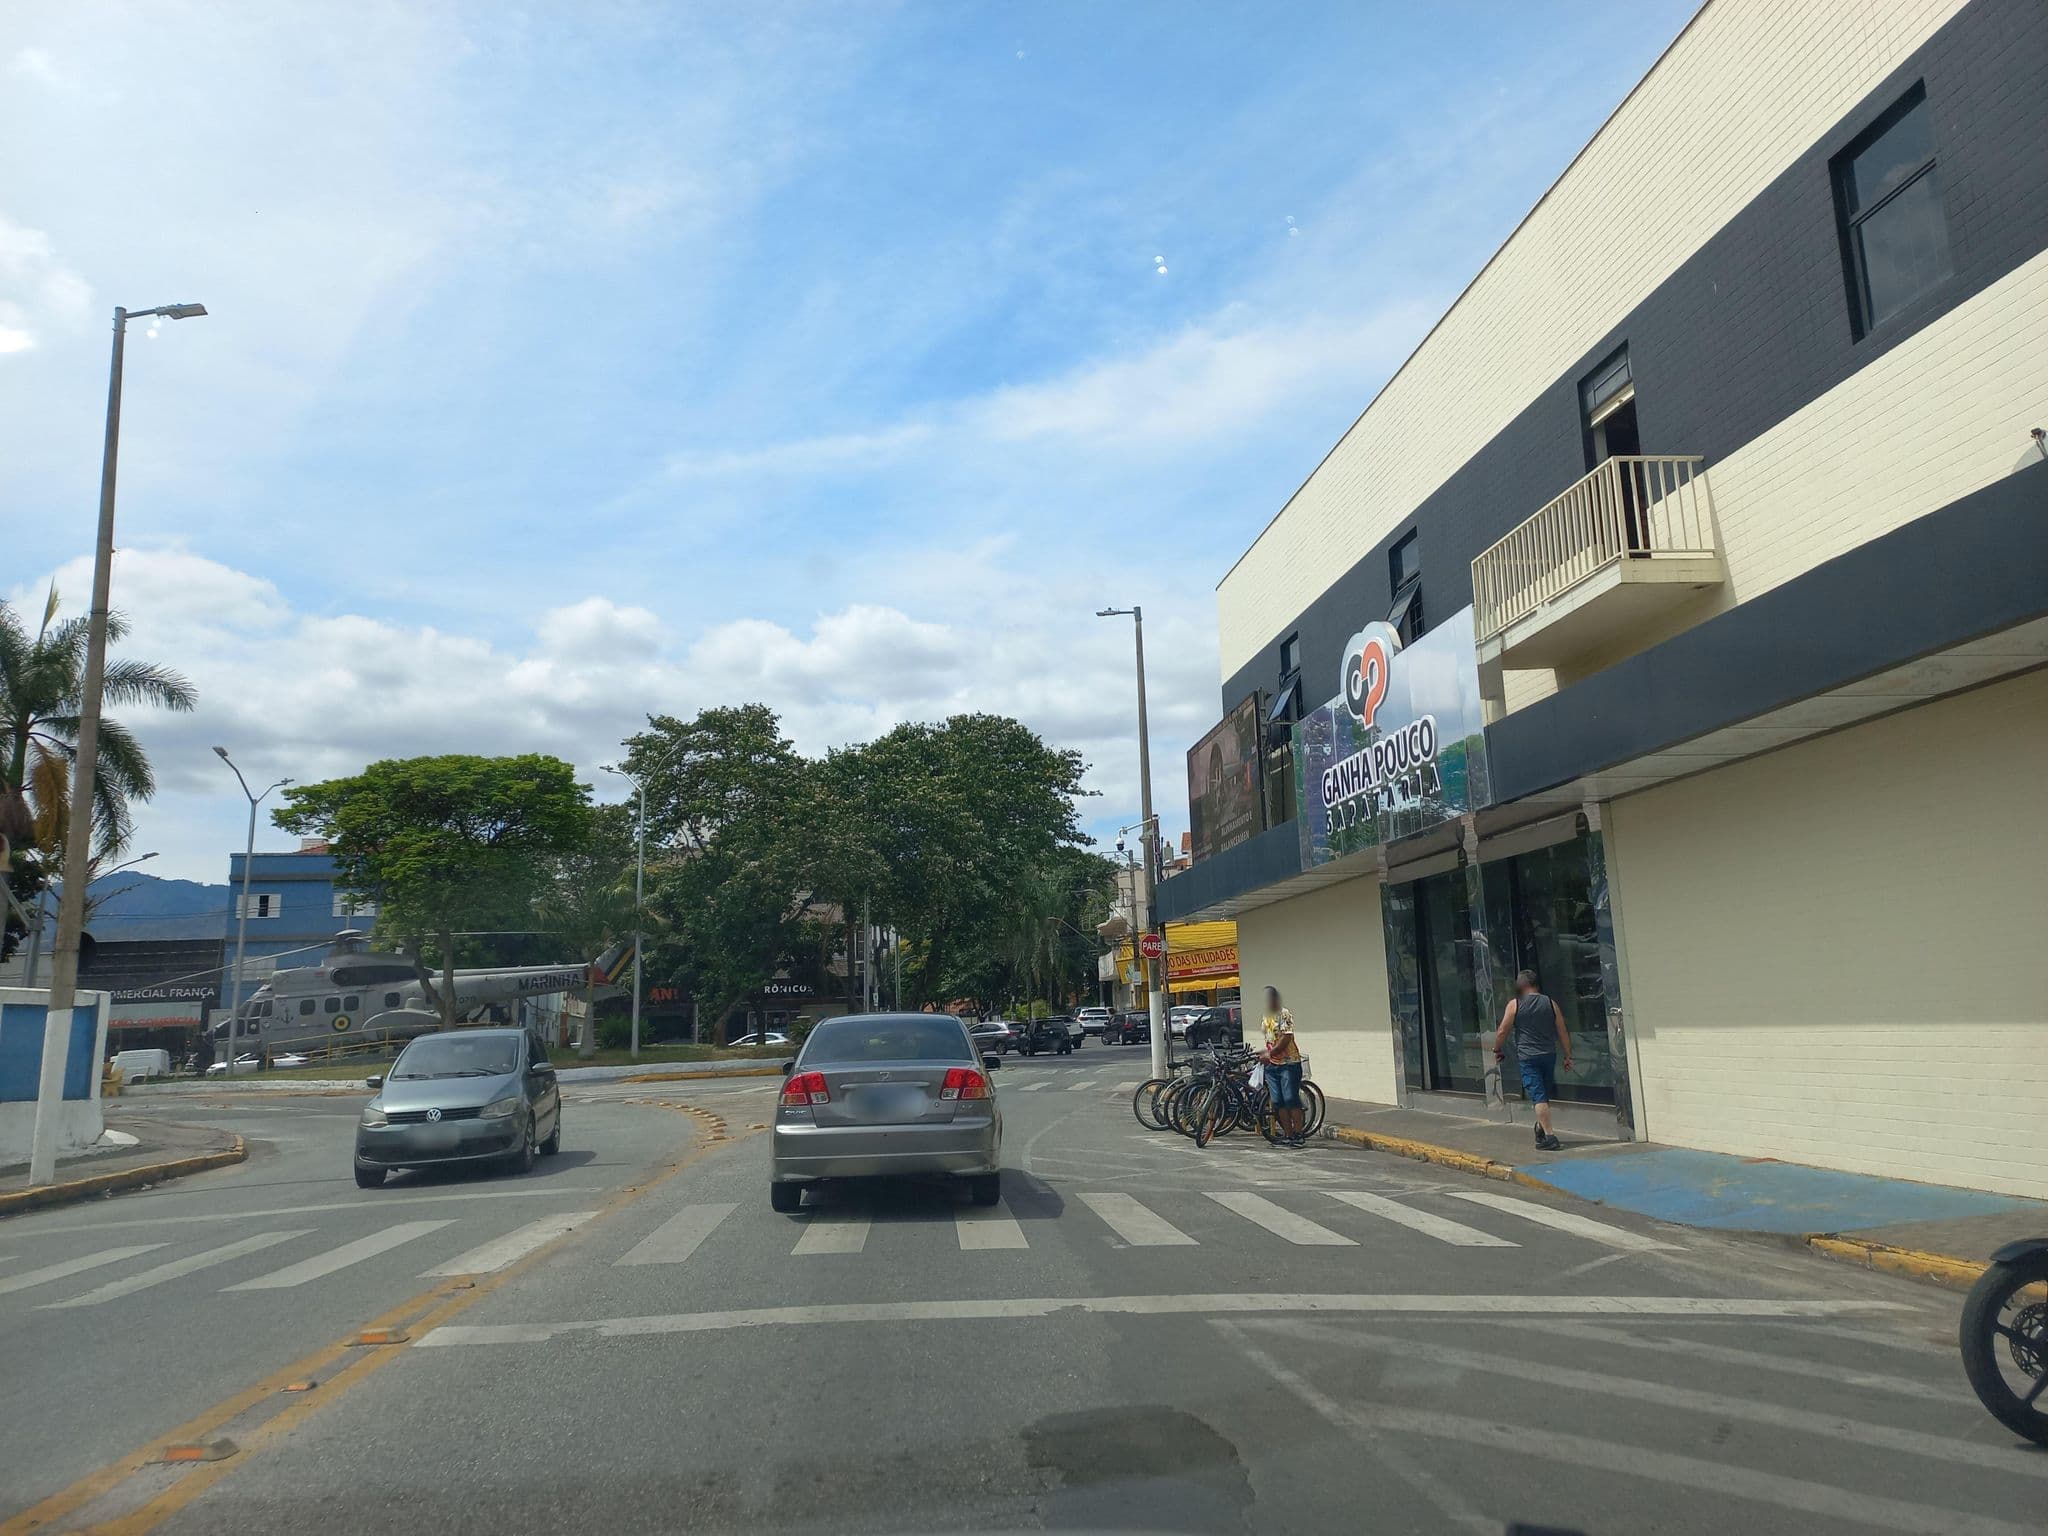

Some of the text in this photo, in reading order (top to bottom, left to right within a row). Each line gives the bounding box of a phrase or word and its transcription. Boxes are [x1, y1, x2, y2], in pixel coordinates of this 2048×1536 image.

[1321, 714, 1438, 809] GANHA POUCO
[1326, 762, 1441, 836] SAPATARIA
[1142, 942, 1162, 951] PARE
[1176, 955, 1191, 967] DAS
[1192, 949, 1236, 965] UTILIDADES
[519, 973, 580, 991] MARINHA
[110, 987, 216, 1000] OMERCIAL FRANÇA
